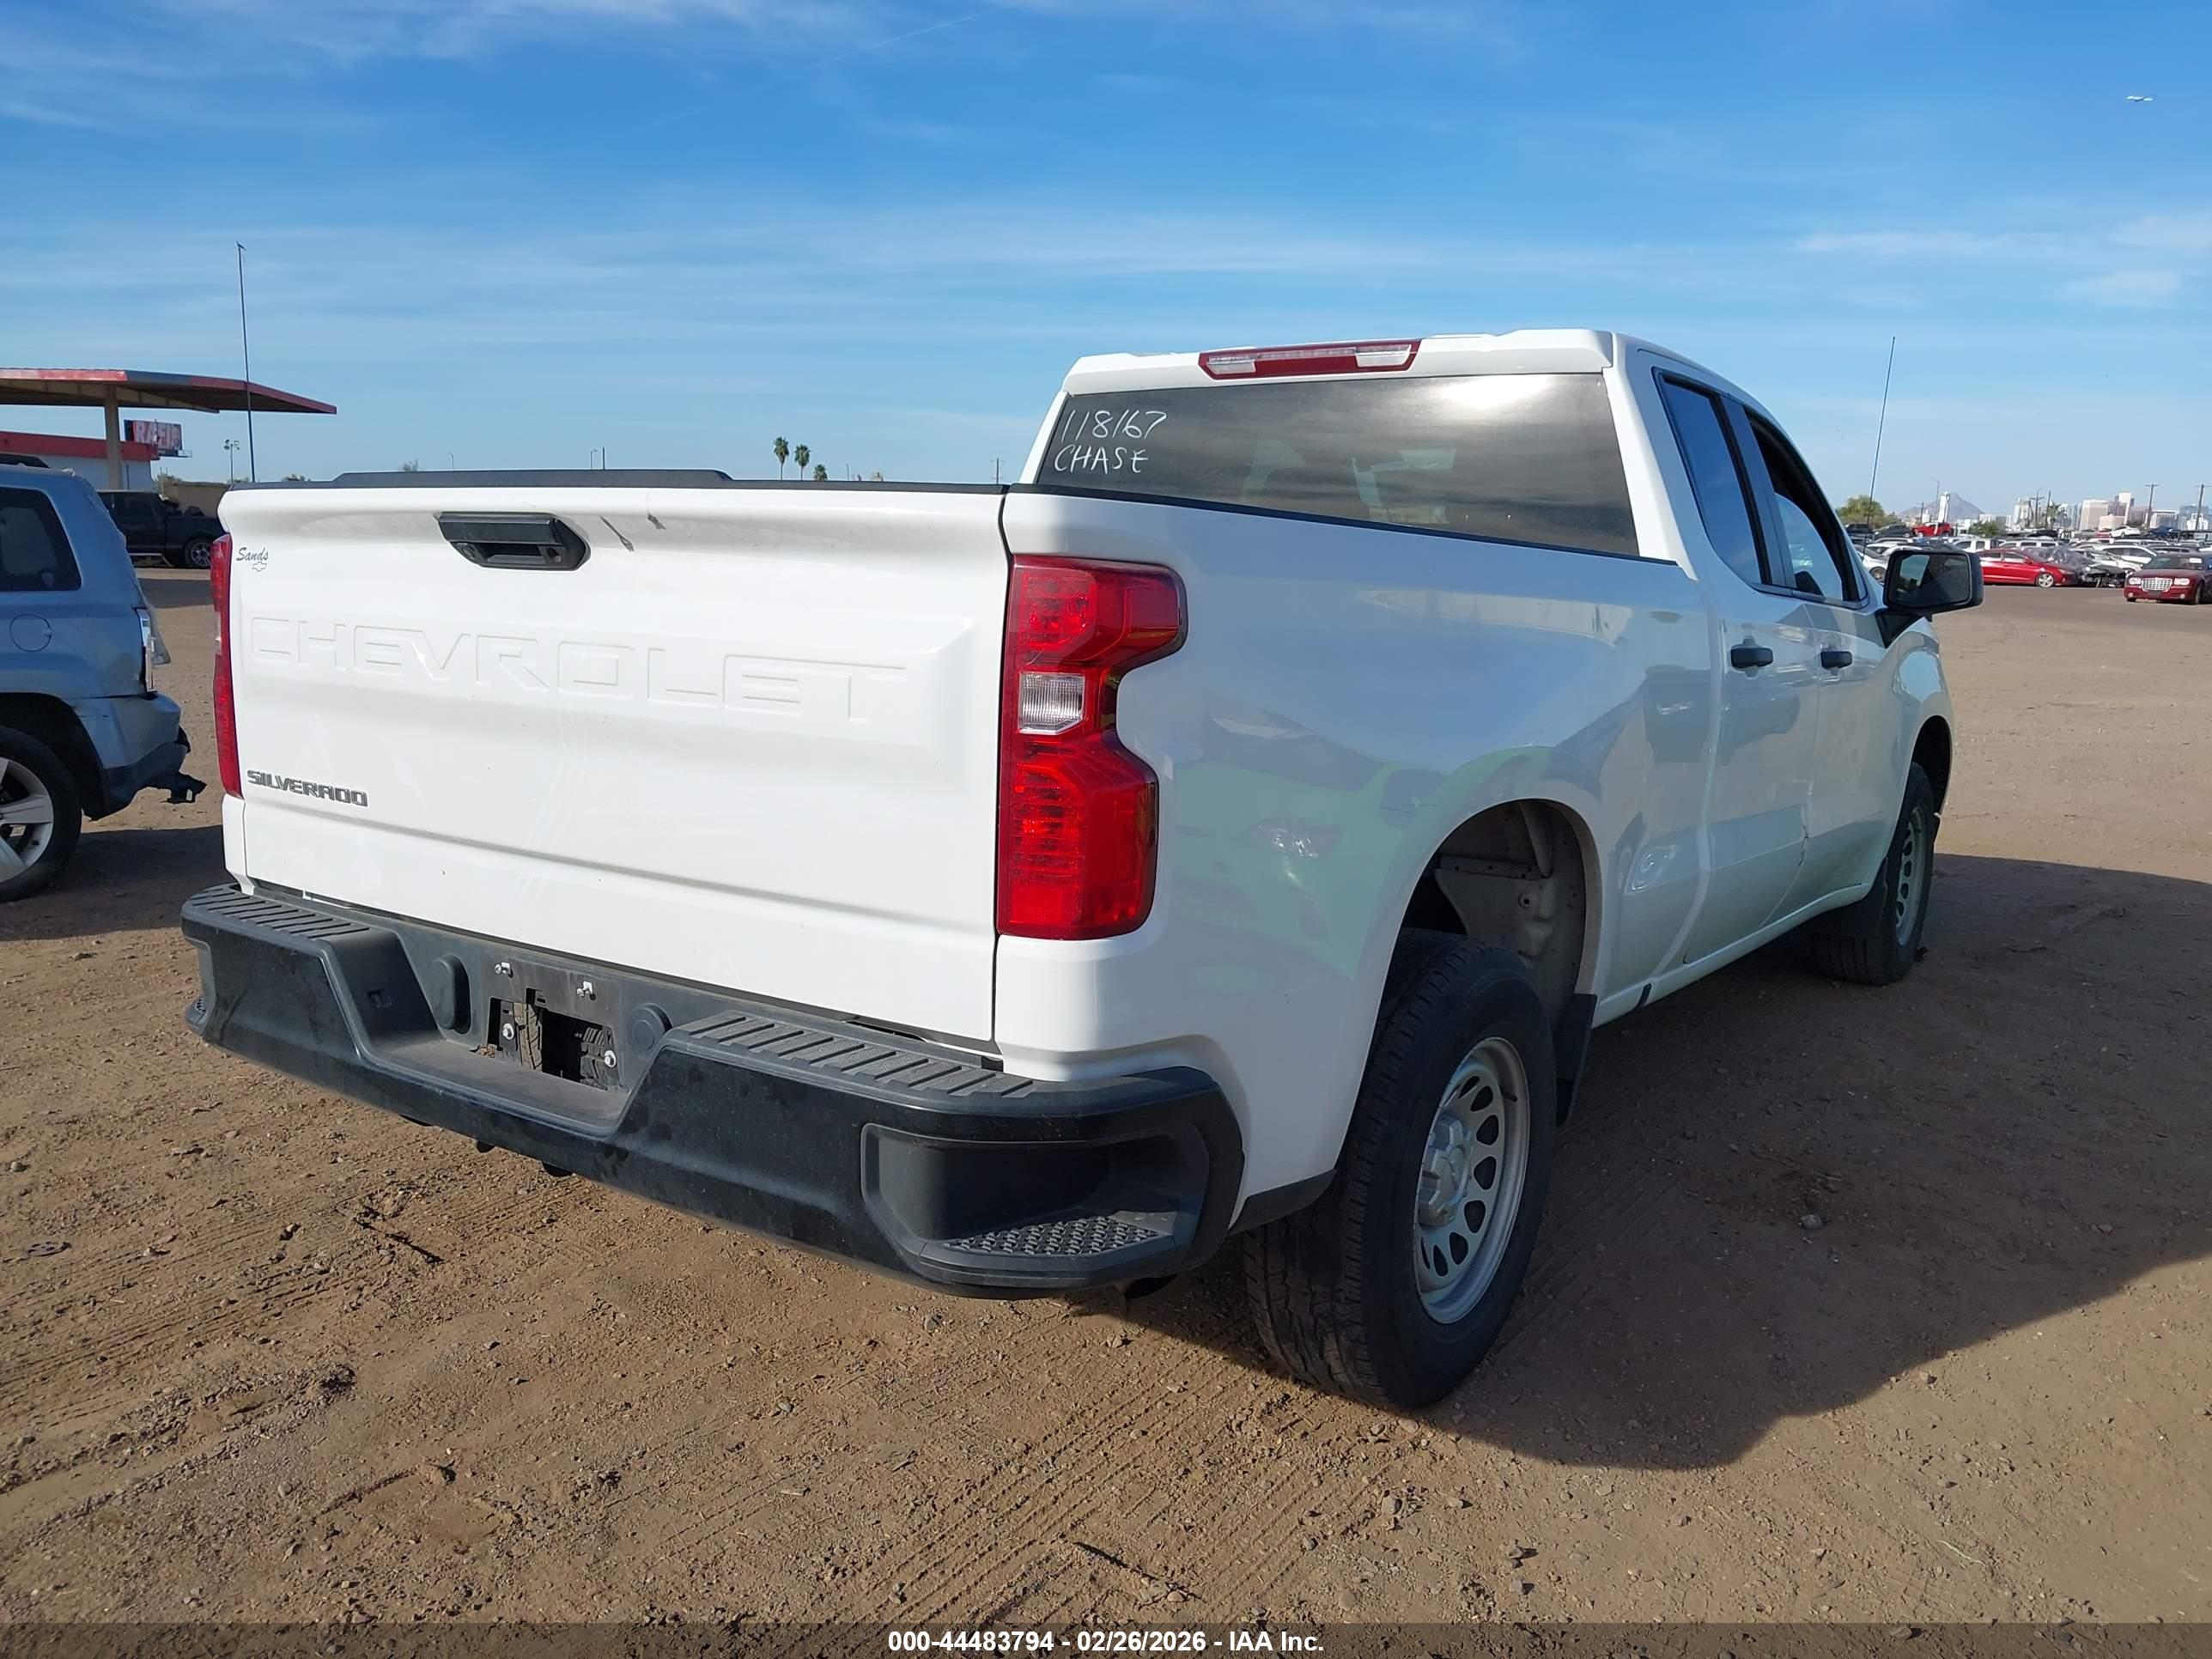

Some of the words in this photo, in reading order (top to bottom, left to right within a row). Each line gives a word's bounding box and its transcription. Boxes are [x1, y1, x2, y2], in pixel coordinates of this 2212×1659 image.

[1060, 409, 1167, 443] 118167
[1054, 444, 1149, 474] CHASE
[236, 546, 269, 561] Sands
[251, 617, 908, 723] CHEVROLET
[246, 769, 368, 807] SILVERADO
